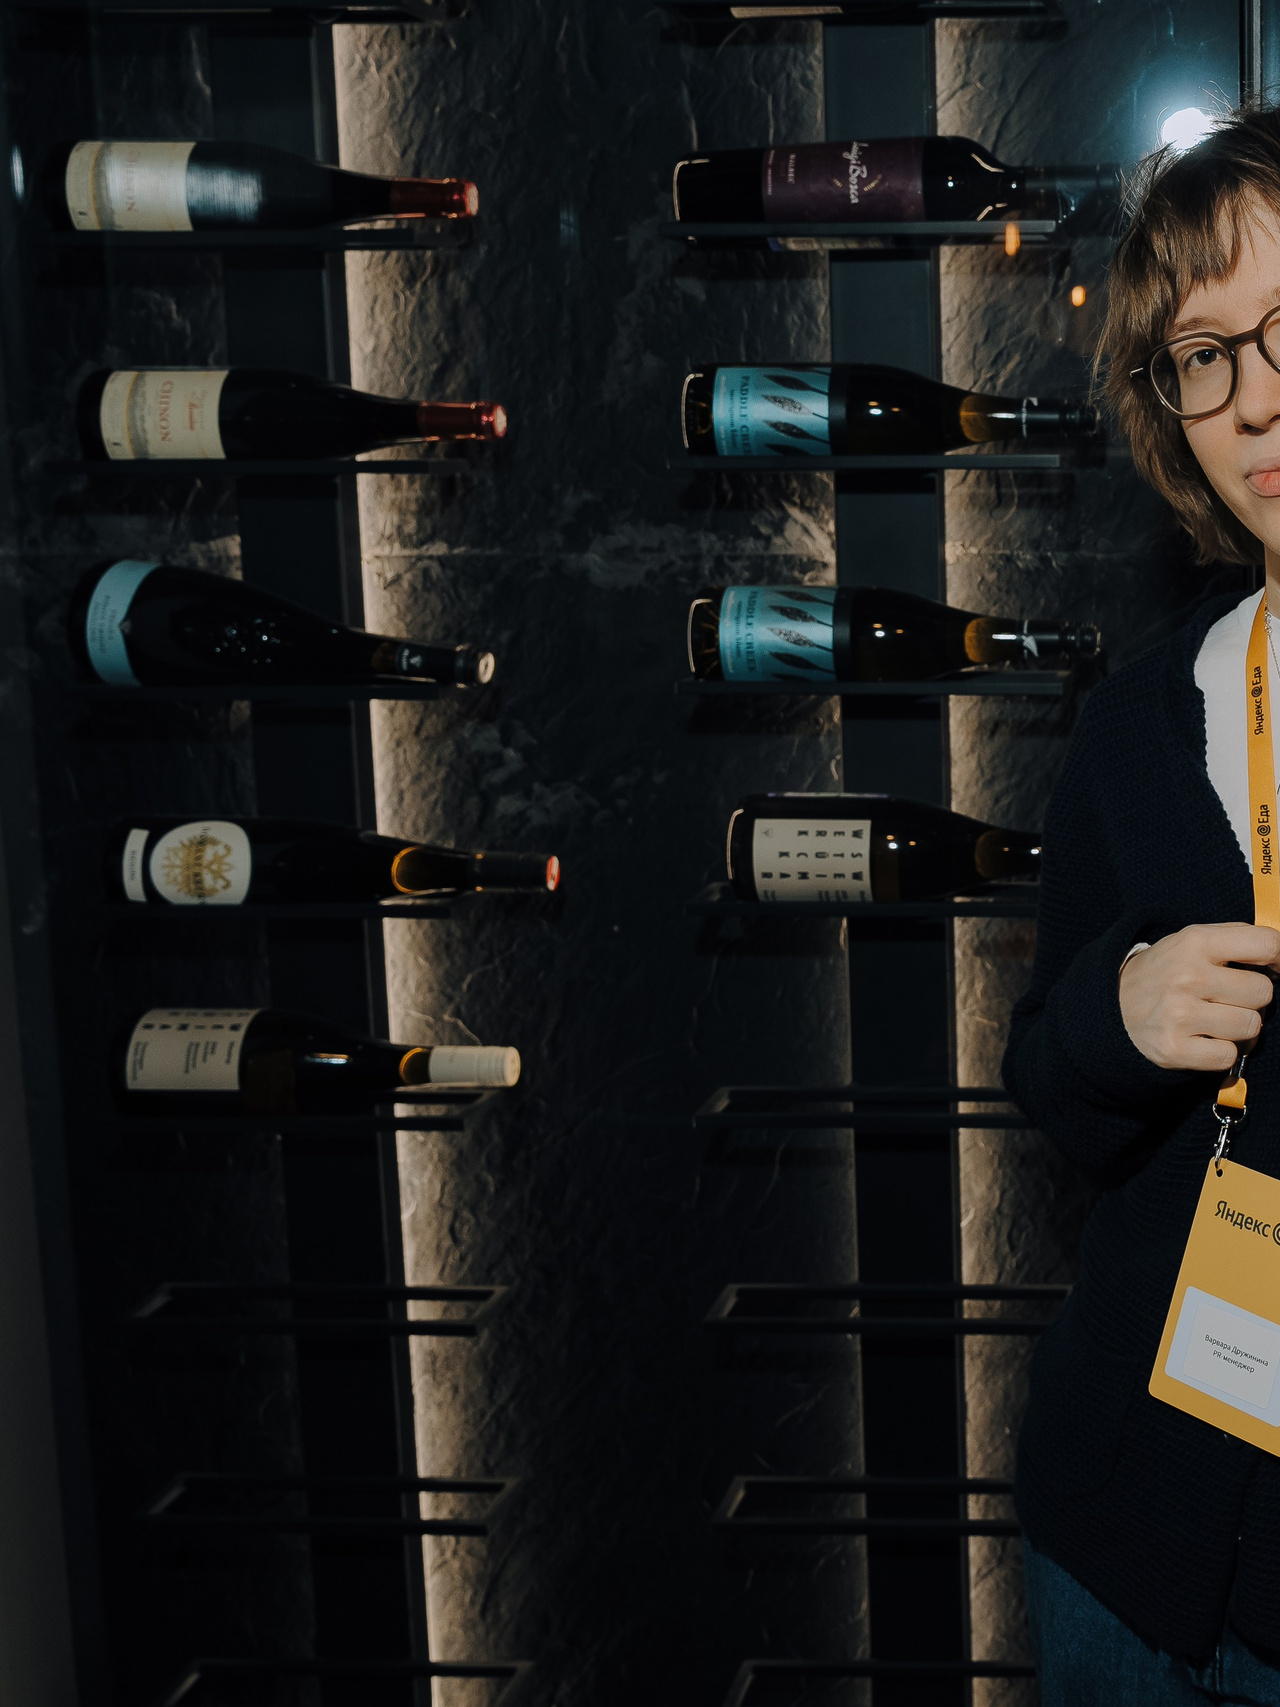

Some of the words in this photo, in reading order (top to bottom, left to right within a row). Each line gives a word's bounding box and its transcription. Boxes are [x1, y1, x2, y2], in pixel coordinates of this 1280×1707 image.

[841, 141, 868, 165] Luigi
[848, 165, 868, 204] Bosca
[157, 380, 174, 442] CHINON
[739, 375, 752, 422] PADDLE
[745, 633, 758, 673] CREEK
[1252, 666, 1262, 686] Еда
[1254, 697, 1264, 735] Яндекс
[1258, 804, 1270, 824] Еда
[797, 829, 864, 839] WERK
[778, 851, 863, 859] STÜCK
[1261, 837, 1273, 875] Яндекс
[761, 871, 864, 881] WEIMAR
[1214, 1200, 1271, 1238] Яндекс
[1204, 1334, 1231, 1351] Варвара
[1231, 1345, 1269, 1367] Дружинина
[1212, 1349, 1255, 1374] PR-менеджер
